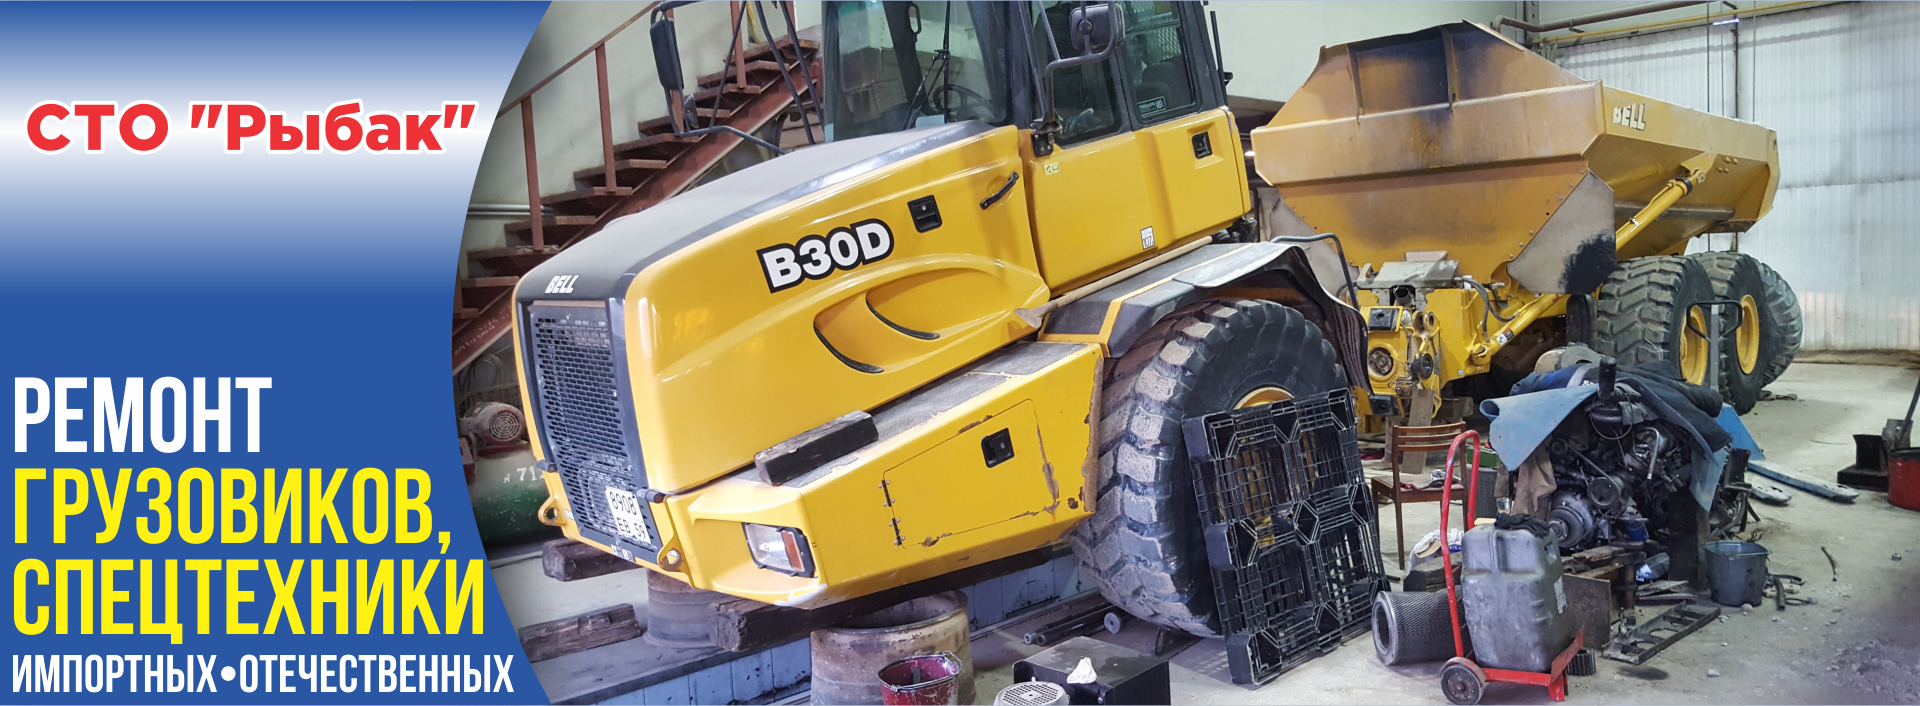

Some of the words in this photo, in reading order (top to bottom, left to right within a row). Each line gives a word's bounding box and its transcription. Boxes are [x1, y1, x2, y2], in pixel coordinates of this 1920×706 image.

[1612, 103, 1646, 131] BELL
[759, 220, 893, 291] B30D
[544, 274, 580, 294] BELL
[609, 491, 637, 516] 8908
[633, 522, 647, 539] 59
